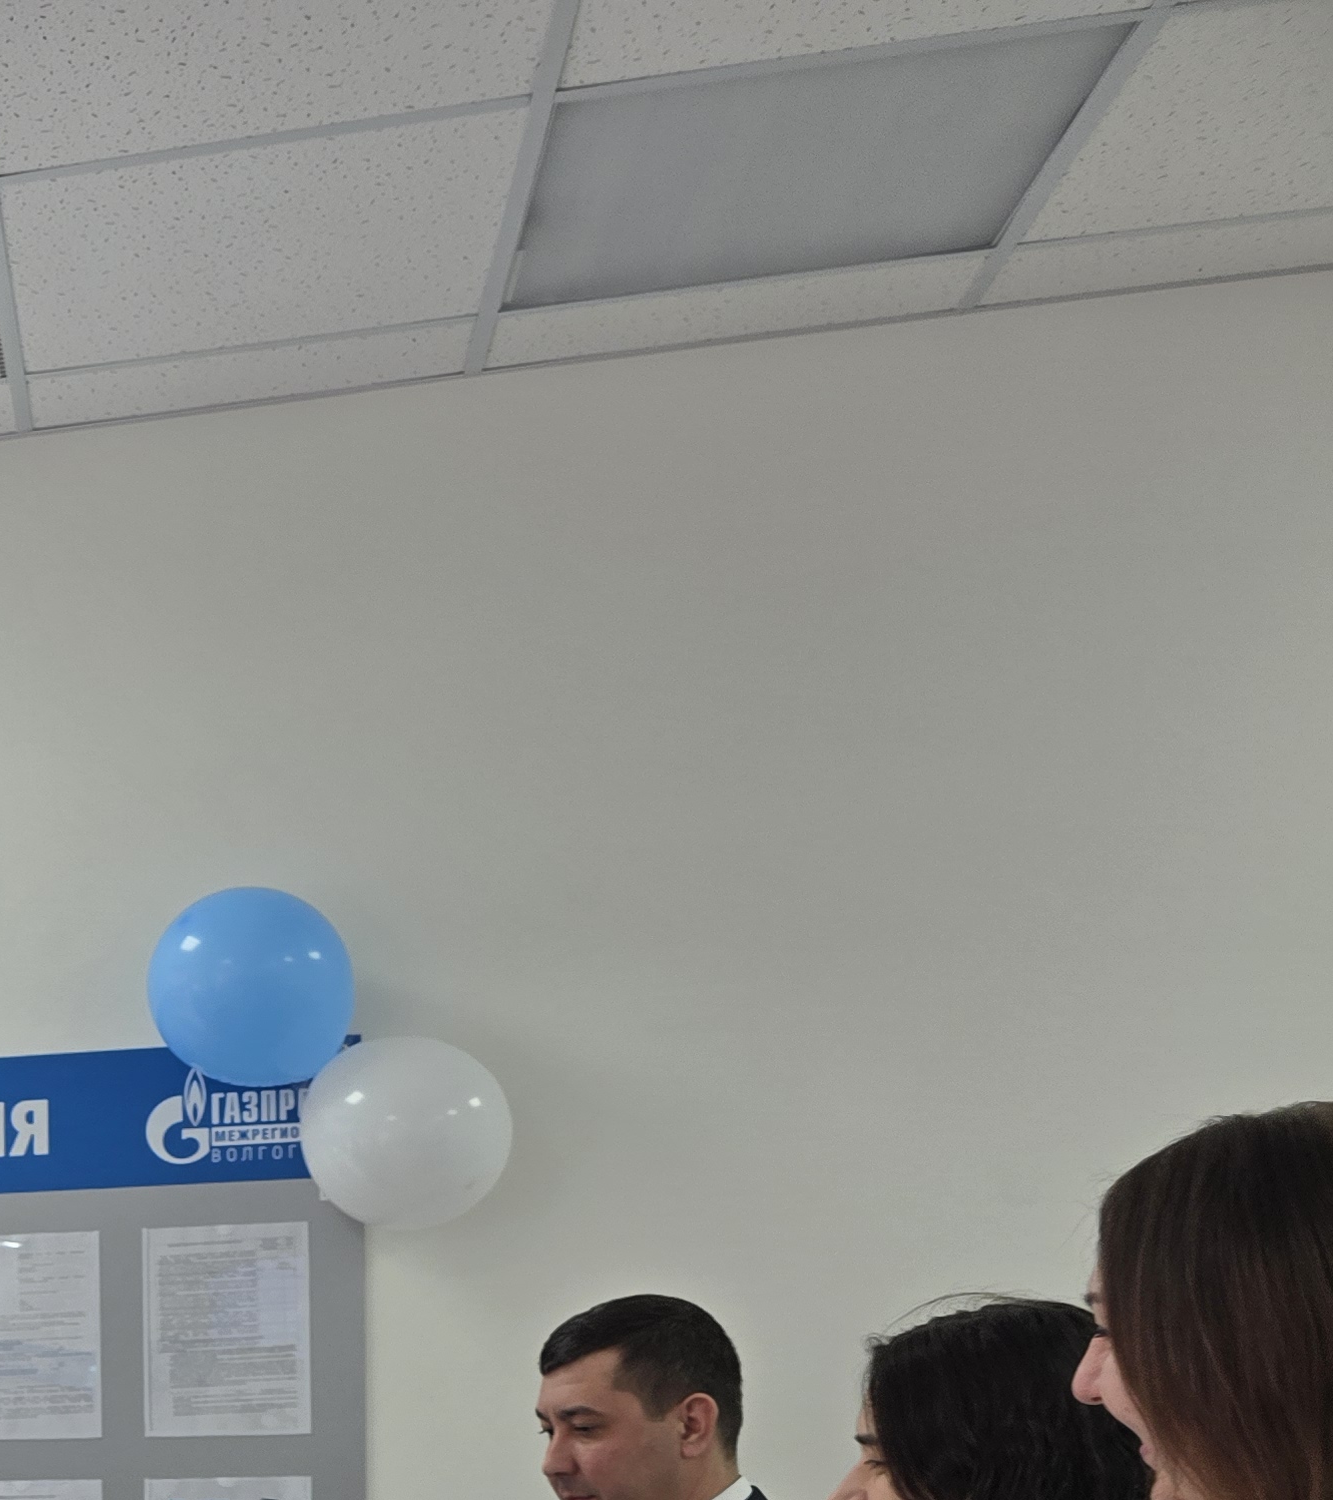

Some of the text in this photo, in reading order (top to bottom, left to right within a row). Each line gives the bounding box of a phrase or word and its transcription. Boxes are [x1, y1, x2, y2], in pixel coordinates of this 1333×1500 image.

[211, 1087, 309, 1125] ГАЗПР
[214, 1126, 300, 1143] МЕЖРЕГИО
[211, 1144, 297, 1163] ВОЛГОГ
